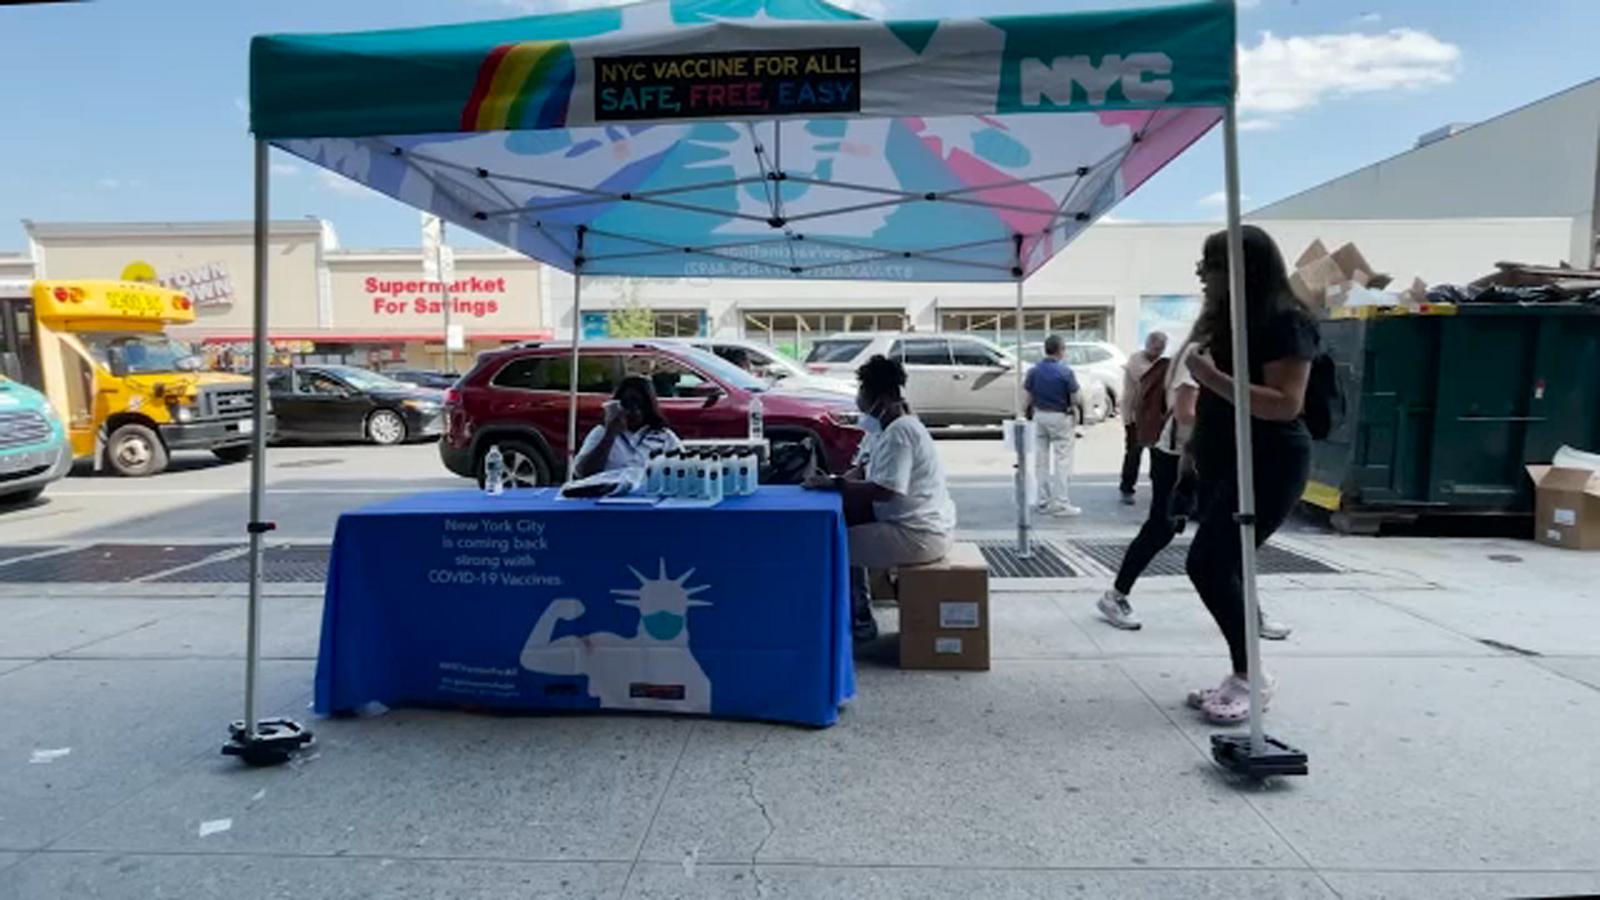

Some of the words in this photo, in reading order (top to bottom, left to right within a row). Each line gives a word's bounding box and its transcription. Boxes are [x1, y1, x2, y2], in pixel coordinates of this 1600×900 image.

[601, 63, 646, 82] NYC
[652, 57, 748, 79] VACCINE
[754, 56, 799, 76] FOR
[804, 54, 857, 74] ALL:
[1020, 52, 1173, 106] NYC
[601, 85, 682, 113] SAFE,
[689, 82, 769, 110] FREE,
[778, 80, 852, 104] EASY
[365, 276, 506, 297] Supermarket
[373, 297, 408, 314] For
[444, 519, 479, 531] New
[481, 519, 513, 532] York
[516, 519, 546, 535] City
[442, 535, 454, 548] is
[457, 538, 510, 553] coming
[513, 536, 548, 550] back
[455, 555, 500, 570] strong
[502, 554, 536, 567] with
[428, 569, 498, 585] COVID-19
